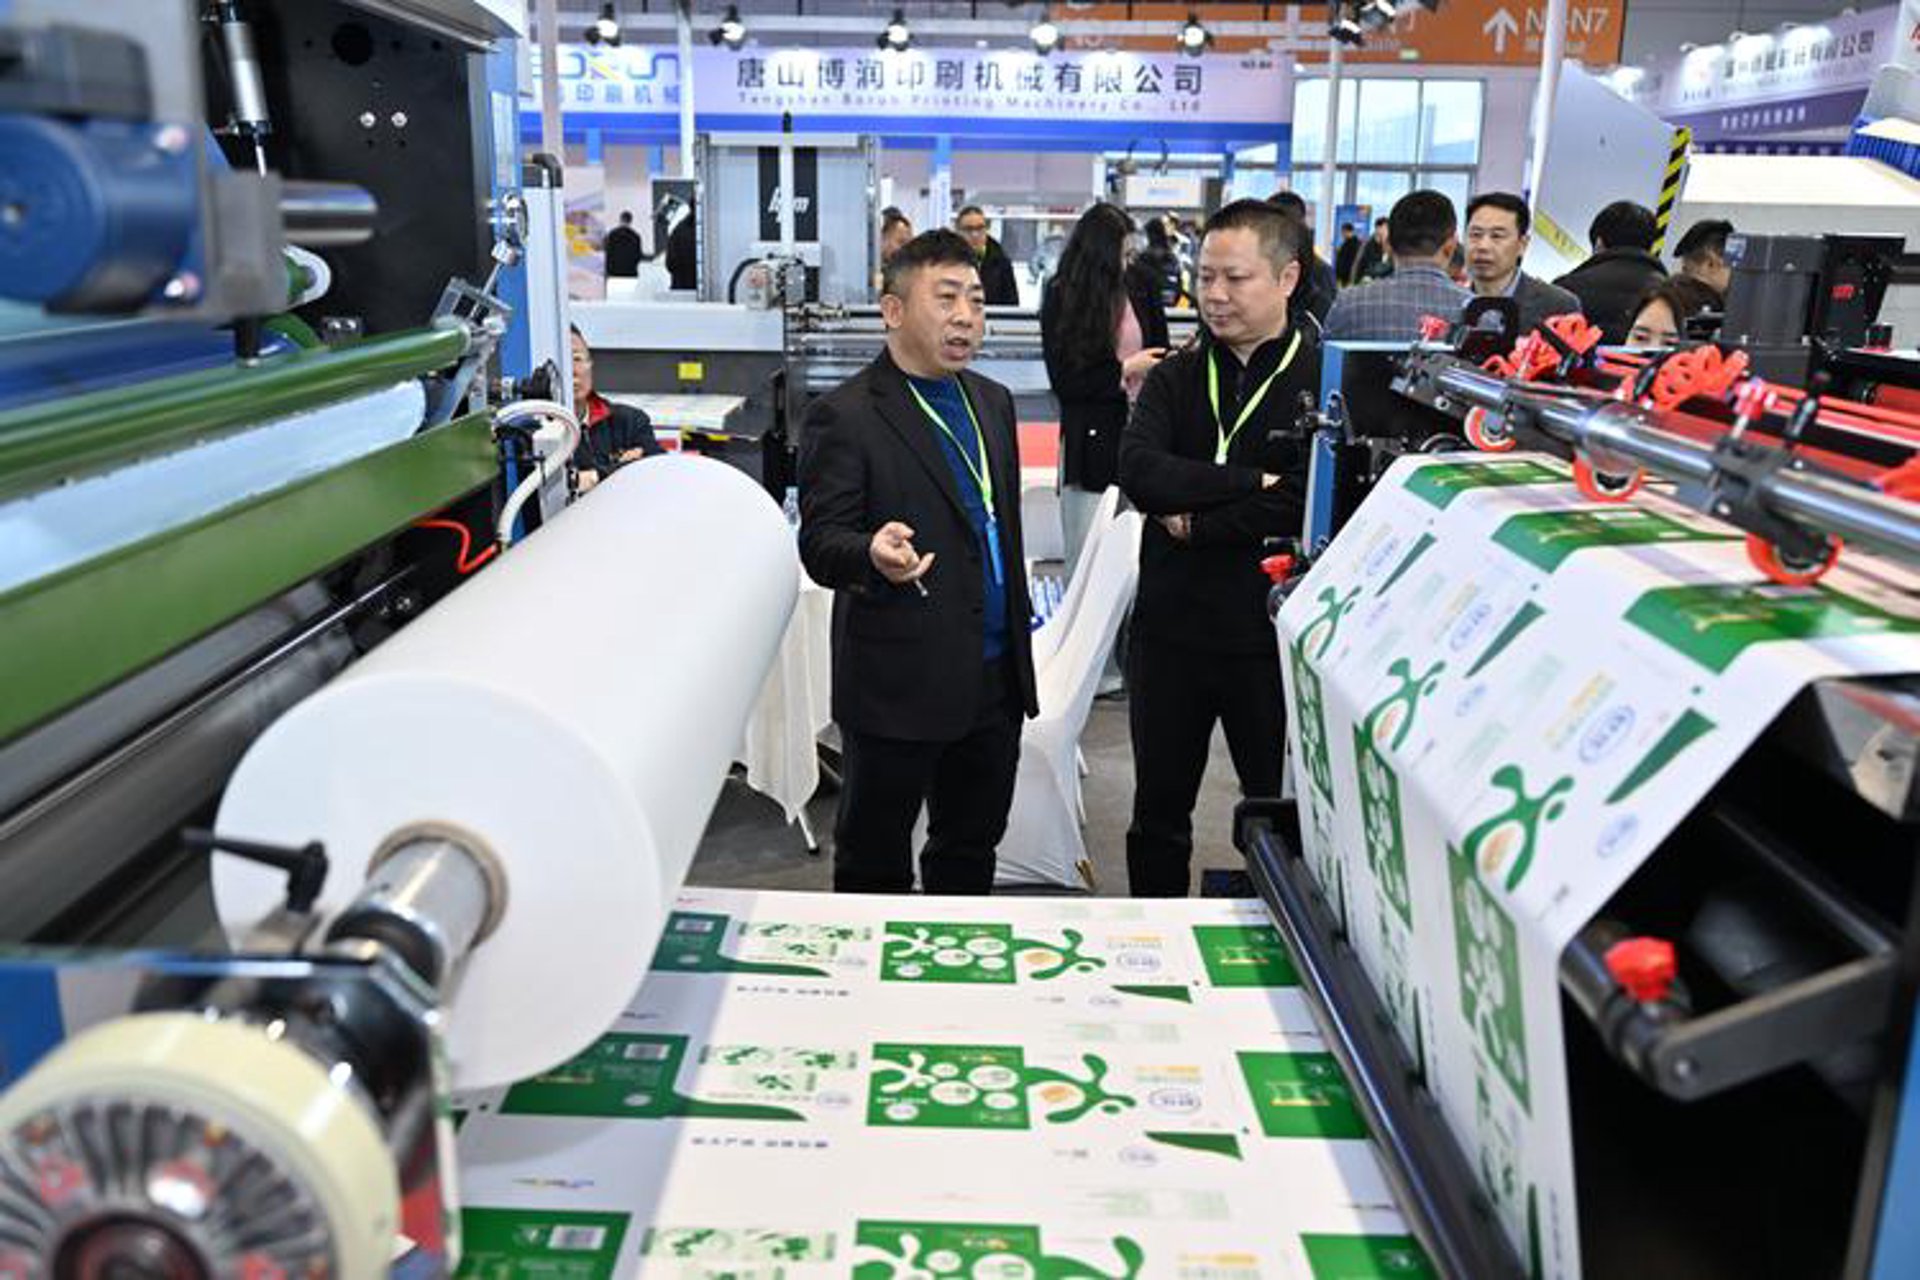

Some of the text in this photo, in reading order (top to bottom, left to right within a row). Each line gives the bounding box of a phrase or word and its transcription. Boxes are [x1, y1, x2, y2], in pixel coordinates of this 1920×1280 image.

[1525, 7, 1608, 34] N-N7
[737, 58, 1202, 95] 唐山博润印刷机械有限公司
